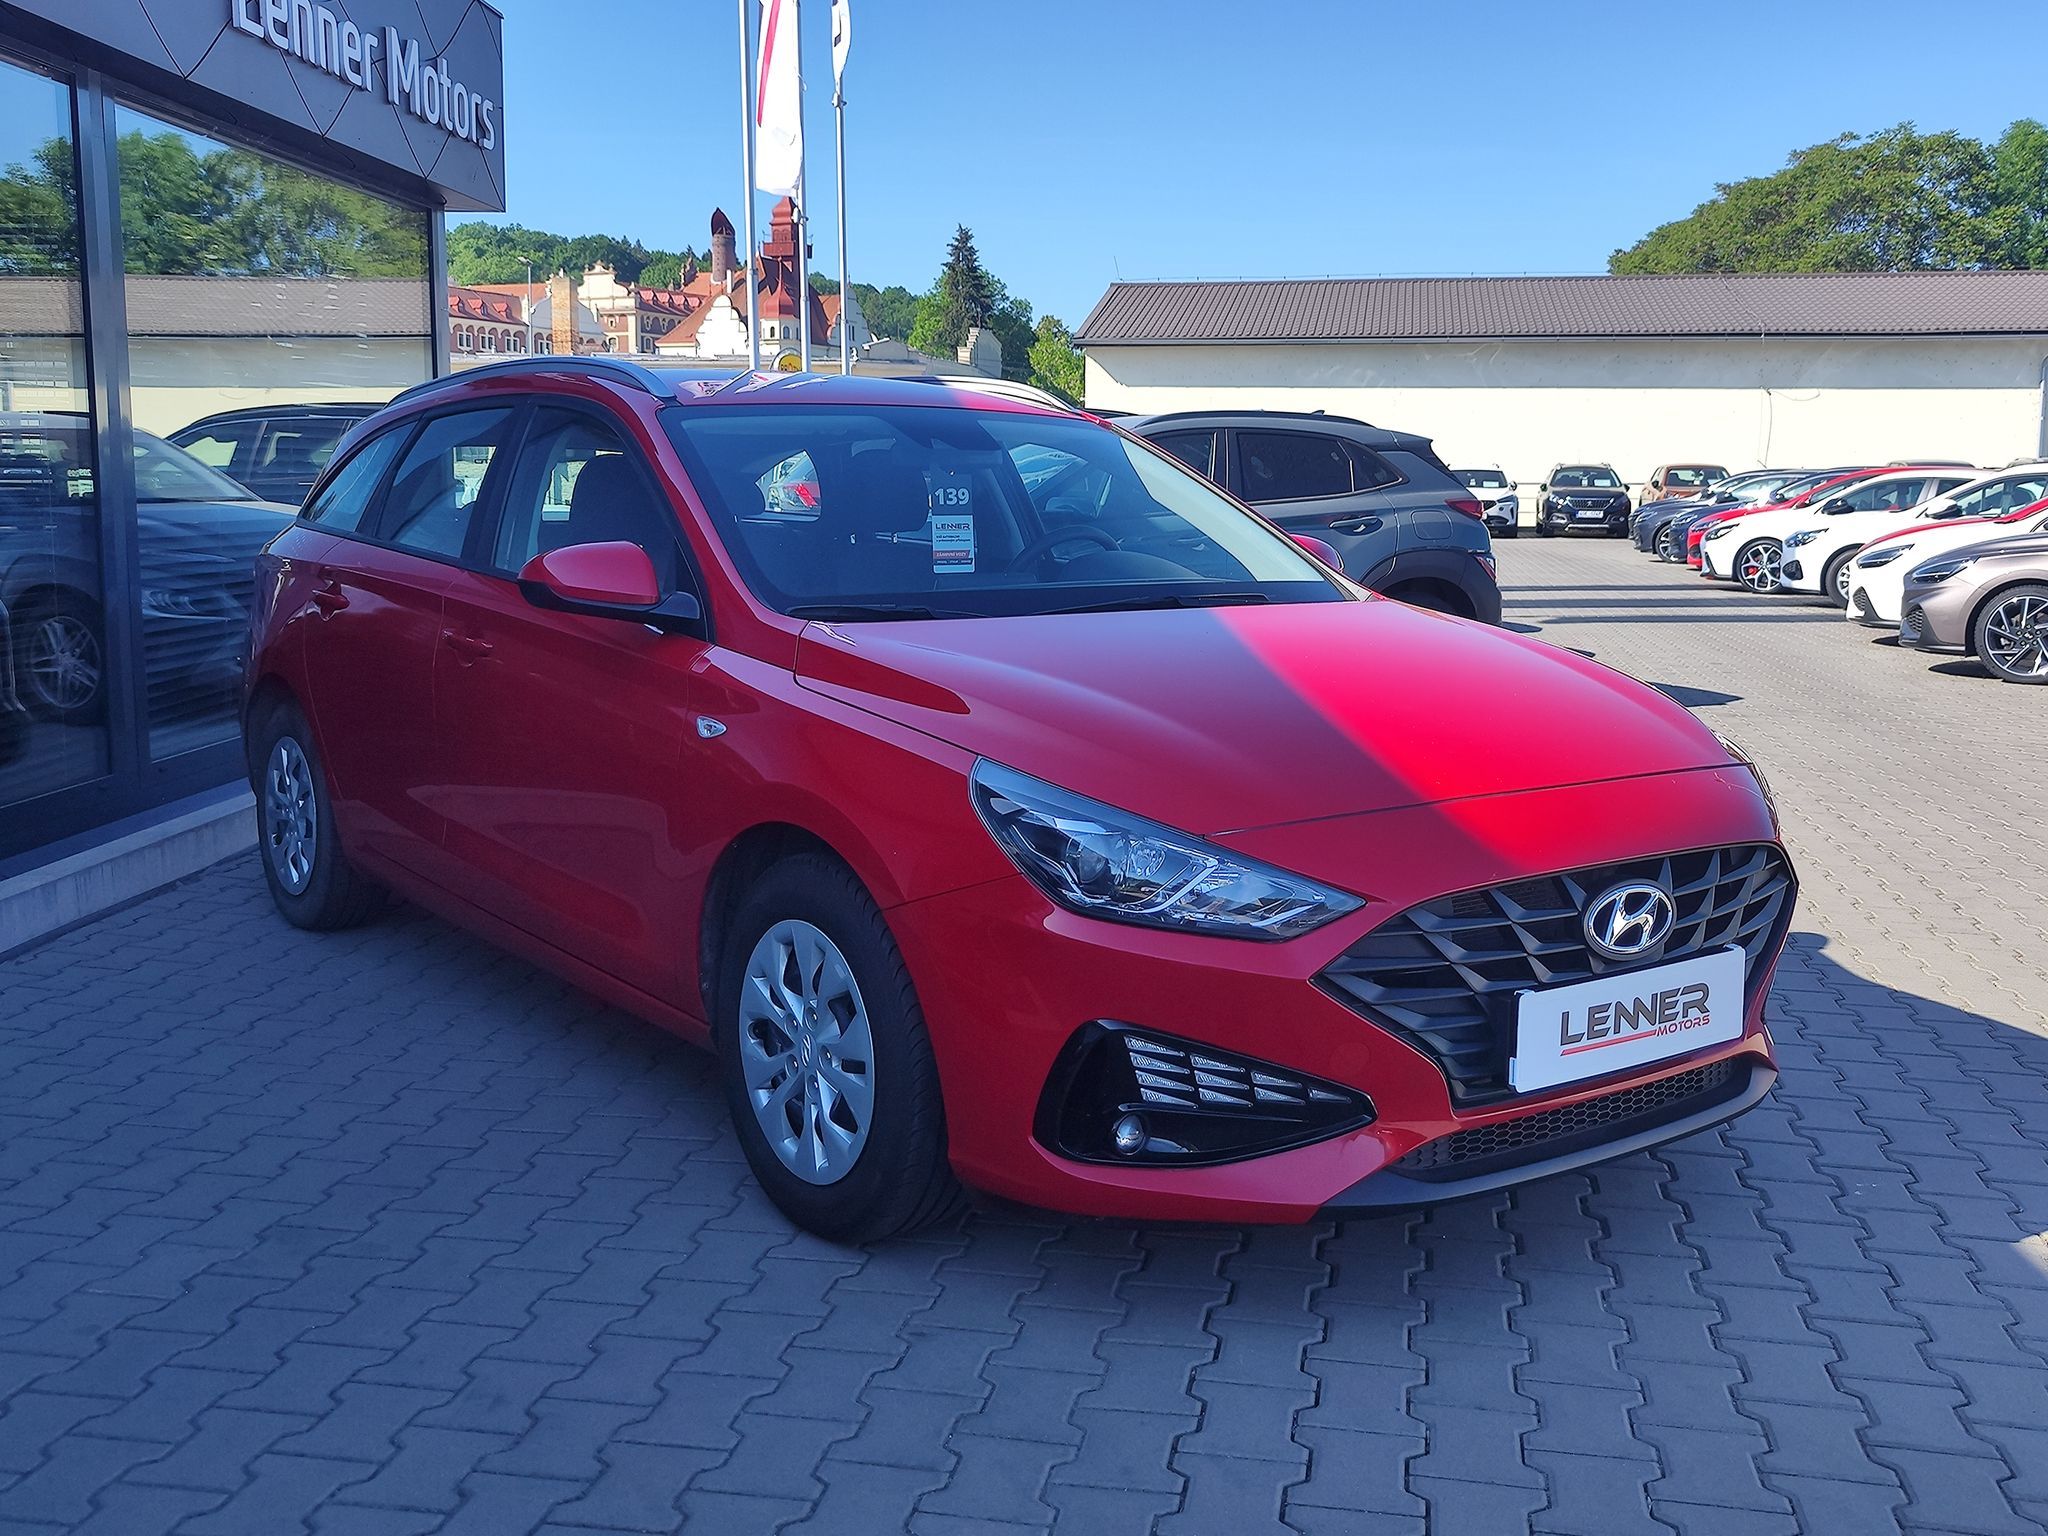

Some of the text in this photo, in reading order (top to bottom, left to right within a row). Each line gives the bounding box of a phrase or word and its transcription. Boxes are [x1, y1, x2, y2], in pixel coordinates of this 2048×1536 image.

[384, 24, 496, 151] Motors
[934, 487, 970, 506] 139
[935, 522, 971, 531] LENNER
[1560, 982, 1711, 1047] LENNER
[1656, 1014, 1711, 1038] MOTORS
